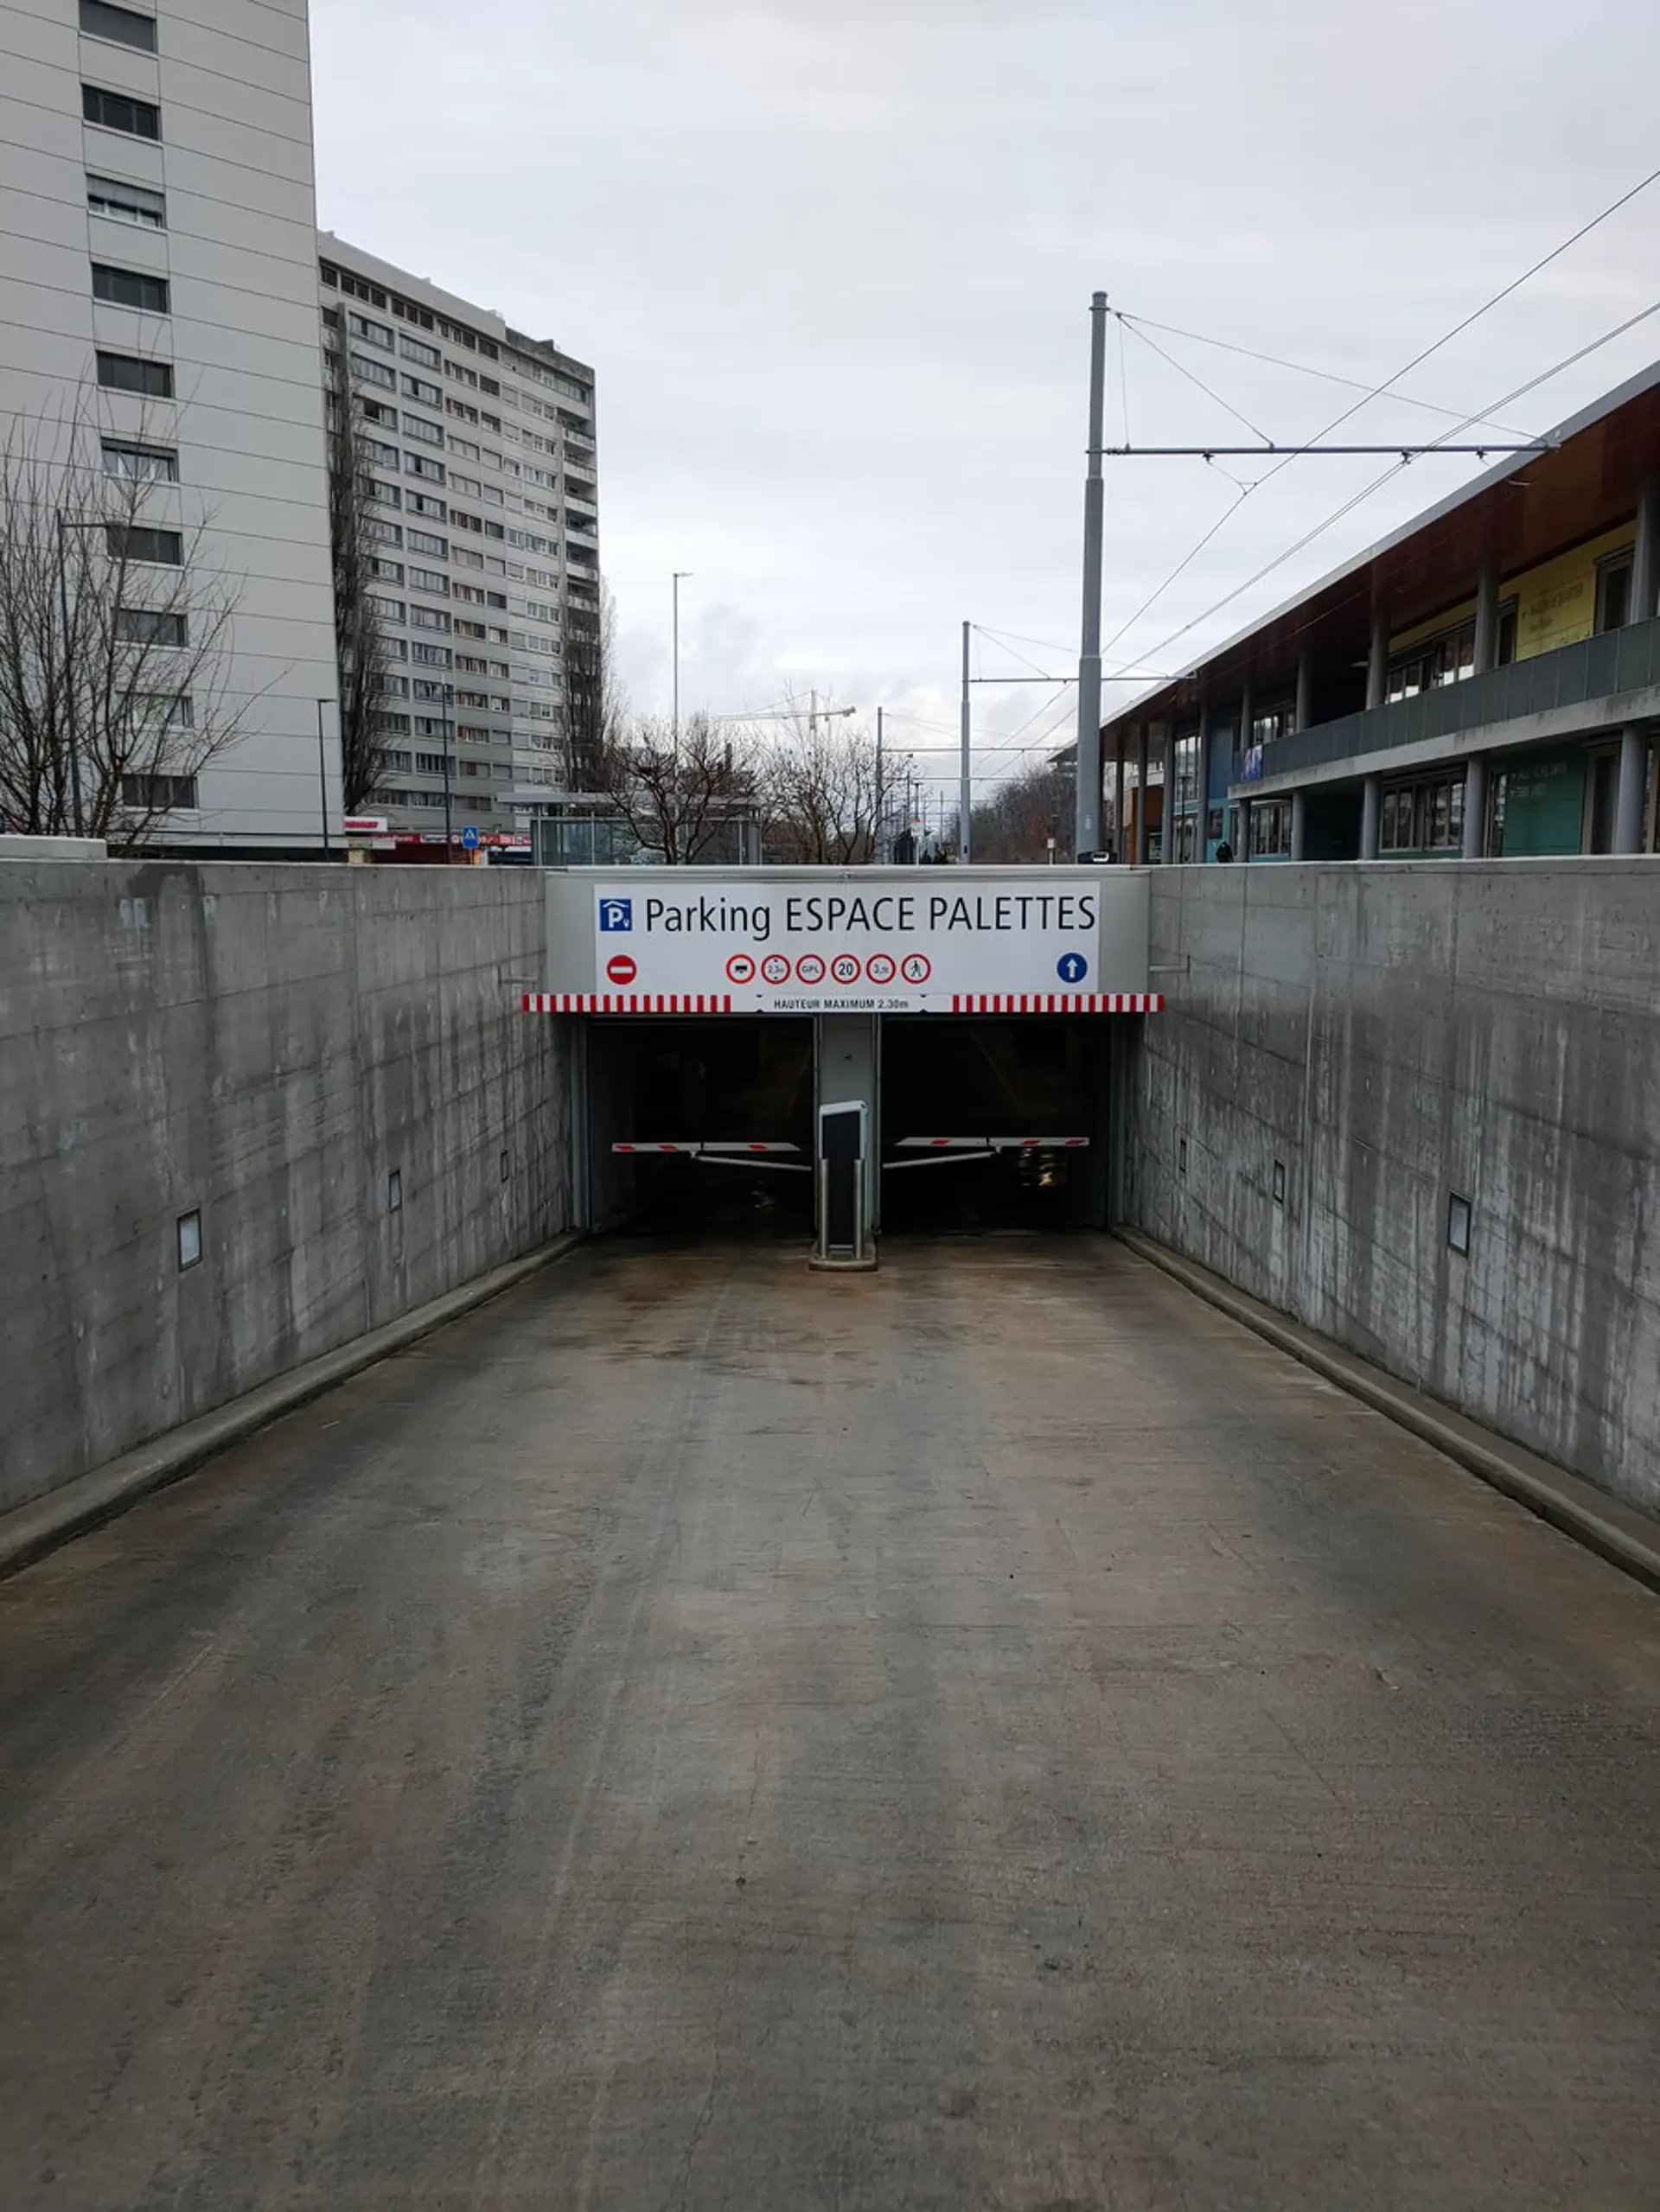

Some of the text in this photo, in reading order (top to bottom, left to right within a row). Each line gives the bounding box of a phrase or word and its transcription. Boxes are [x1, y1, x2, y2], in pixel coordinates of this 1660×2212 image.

[647, 896, 1095, 941] Parking ESPACE PALETTES
[801, 965, 820, 974] GPL
[839, 962, 854, 976] 20
[774, 998, 910, 1009] HAUTEUR MAXIMUM 2.30m
